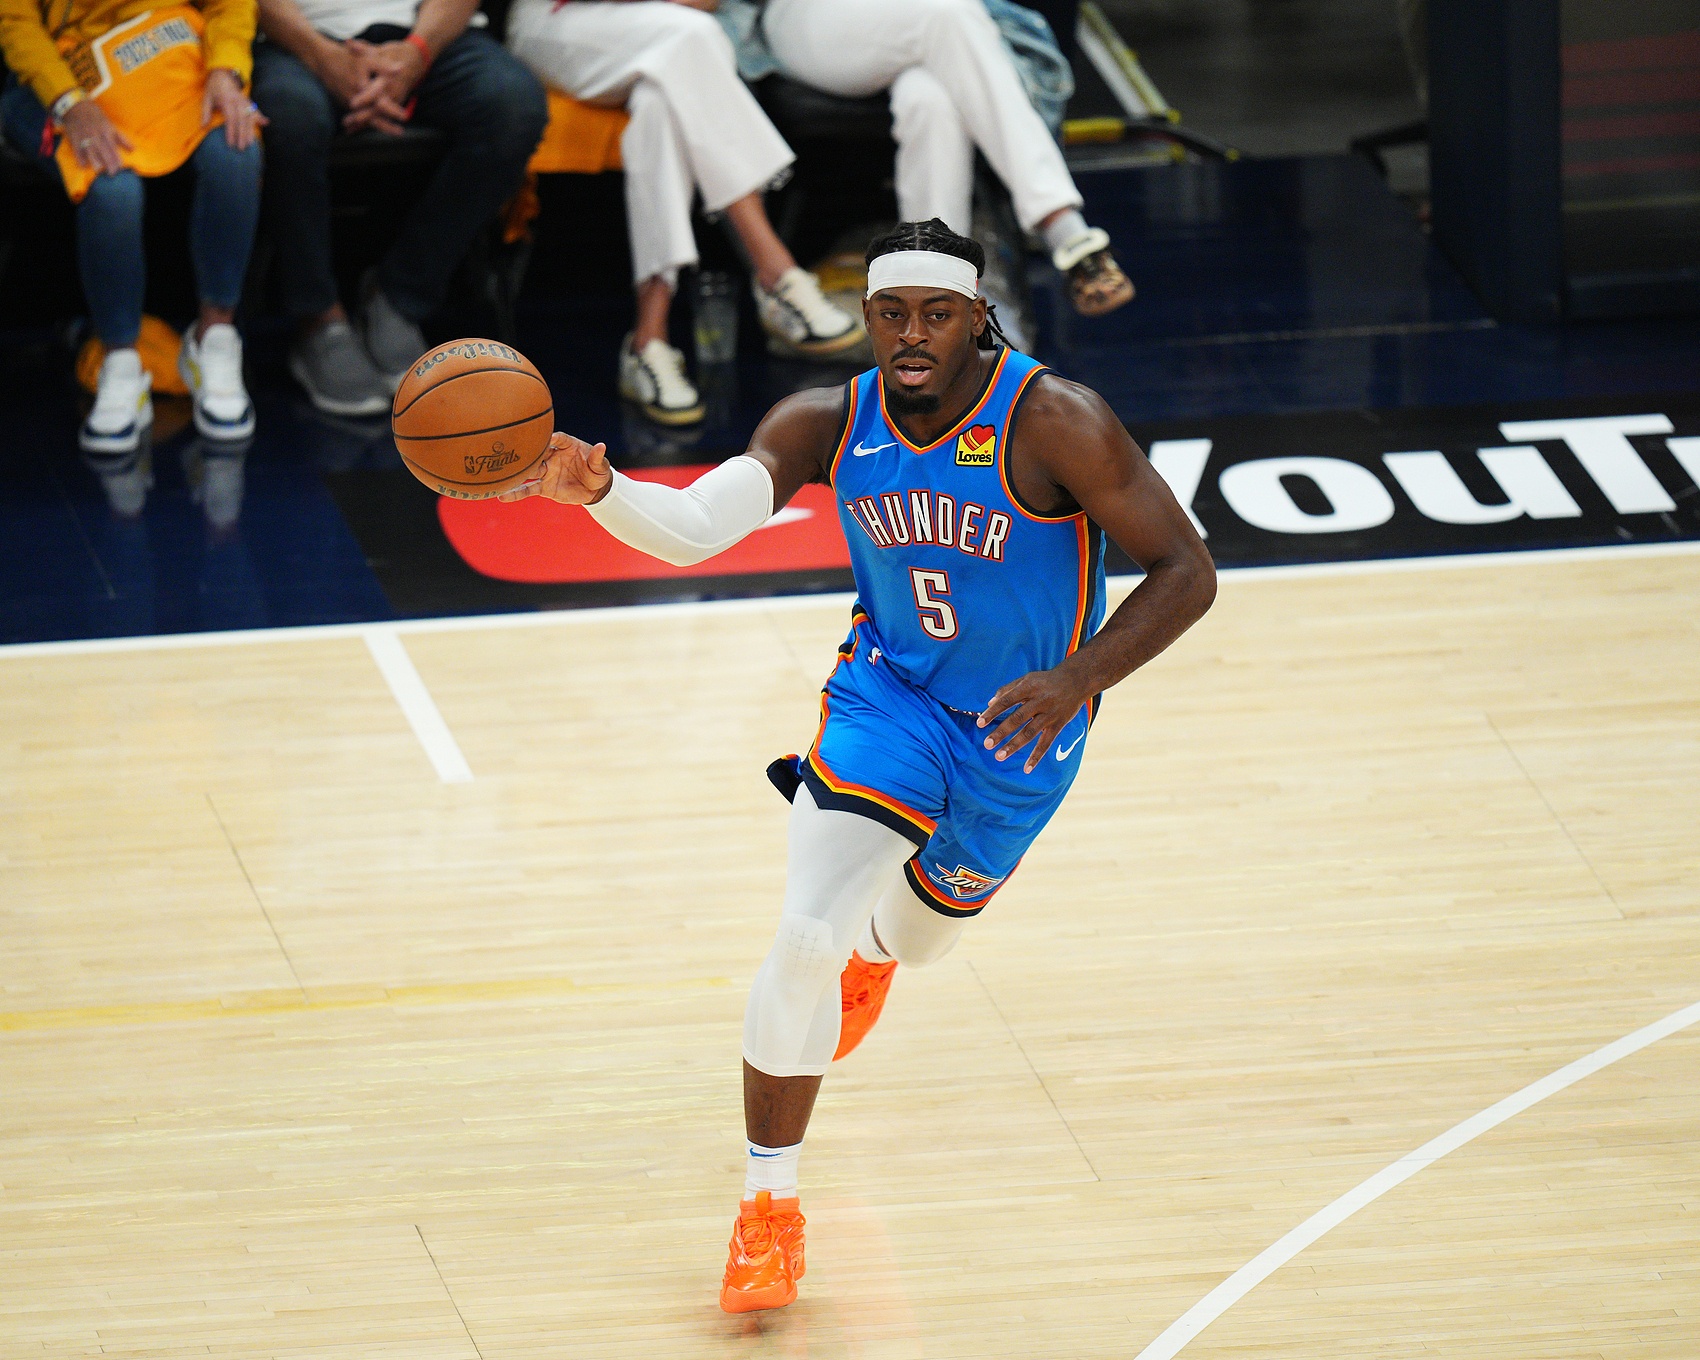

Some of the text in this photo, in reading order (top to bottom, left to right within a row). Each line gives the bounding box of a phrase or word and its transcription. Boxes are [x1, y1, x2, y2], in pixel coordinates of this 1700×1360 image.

[413, 343, 522, 377] Wilson
[474, 449, 520, 475] Finals
[908, 566, 959, 642] 5
